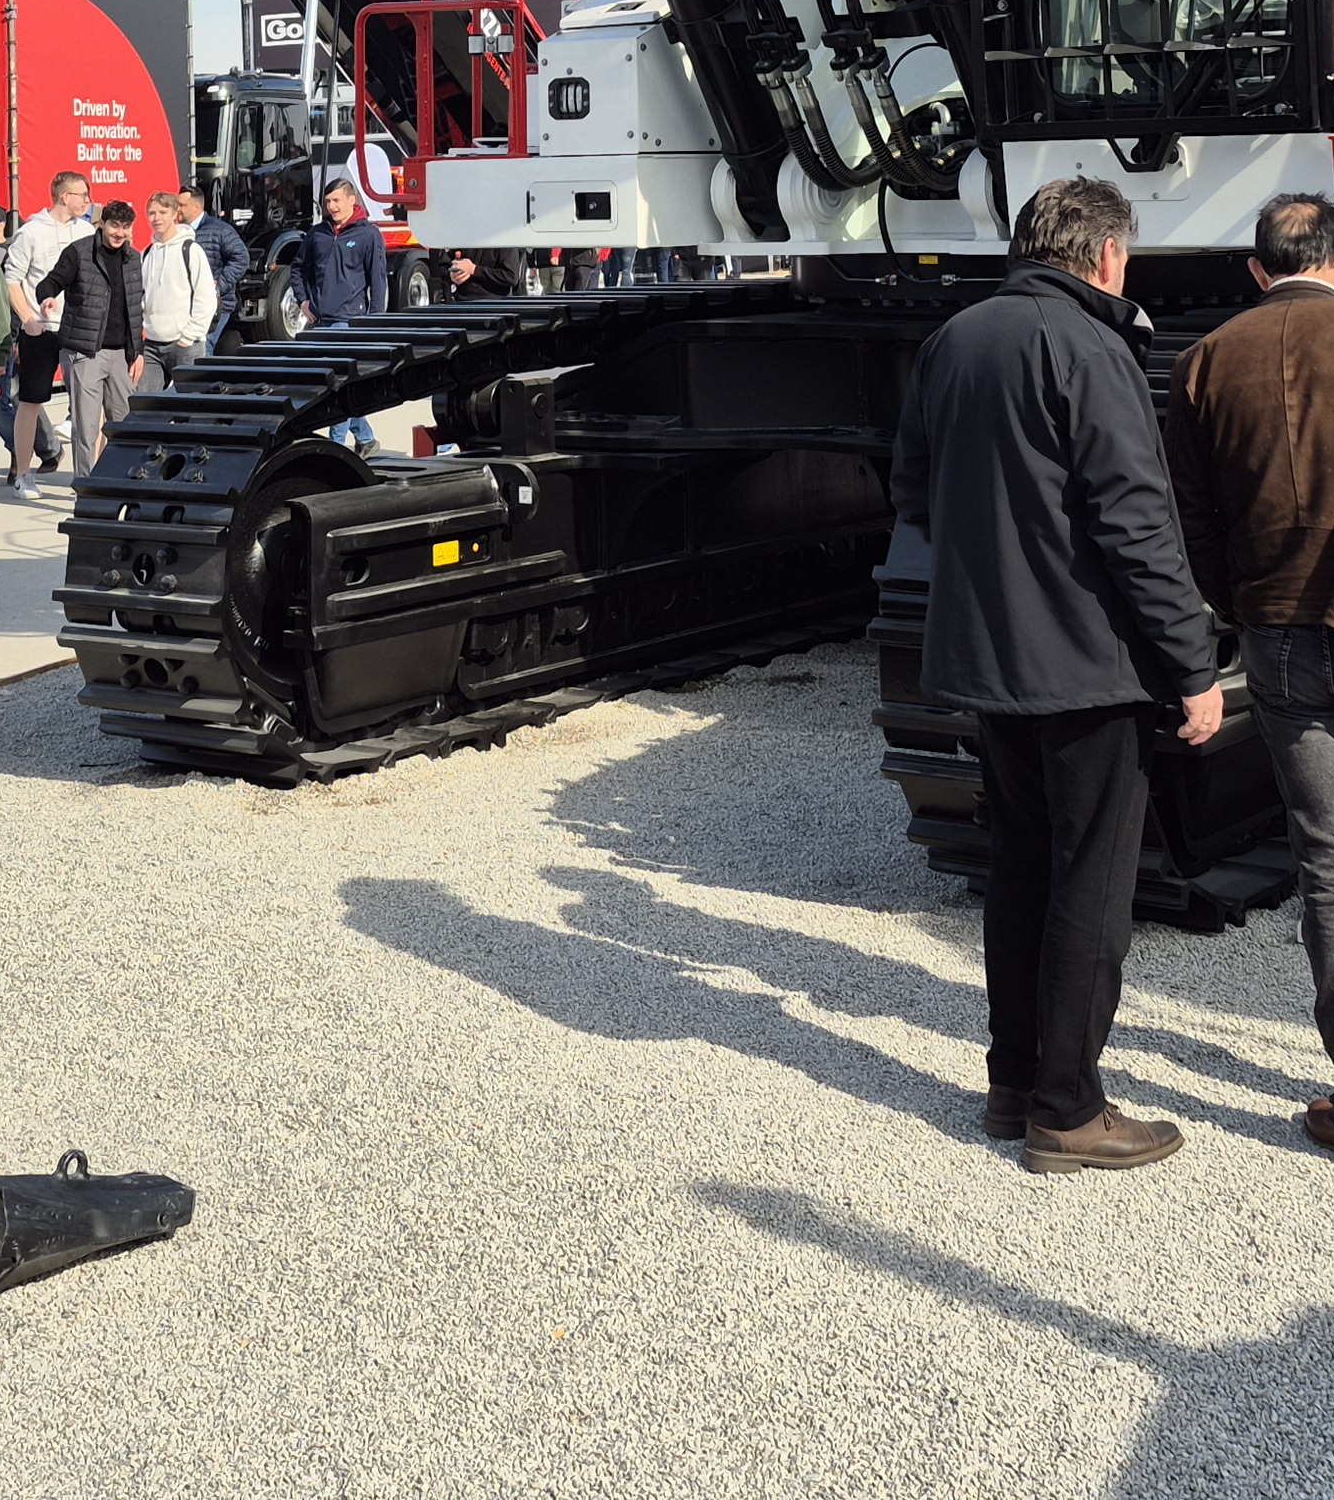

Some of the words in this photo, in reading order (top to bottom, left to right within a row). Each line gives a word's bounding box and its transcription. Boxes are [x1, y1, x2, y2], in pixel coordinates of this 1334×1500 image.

[267, 19, 305, 40] Go
[73, 97, 110, 117] Driven
[112, 99, 126, 121] by
[80, 120, 141, 139] innovation.
[77, 143, 104, 161] Built
[106, 144, 122, 161] for
[124, 143, 142, 162] the
[91, 166, 128, 184] future.
